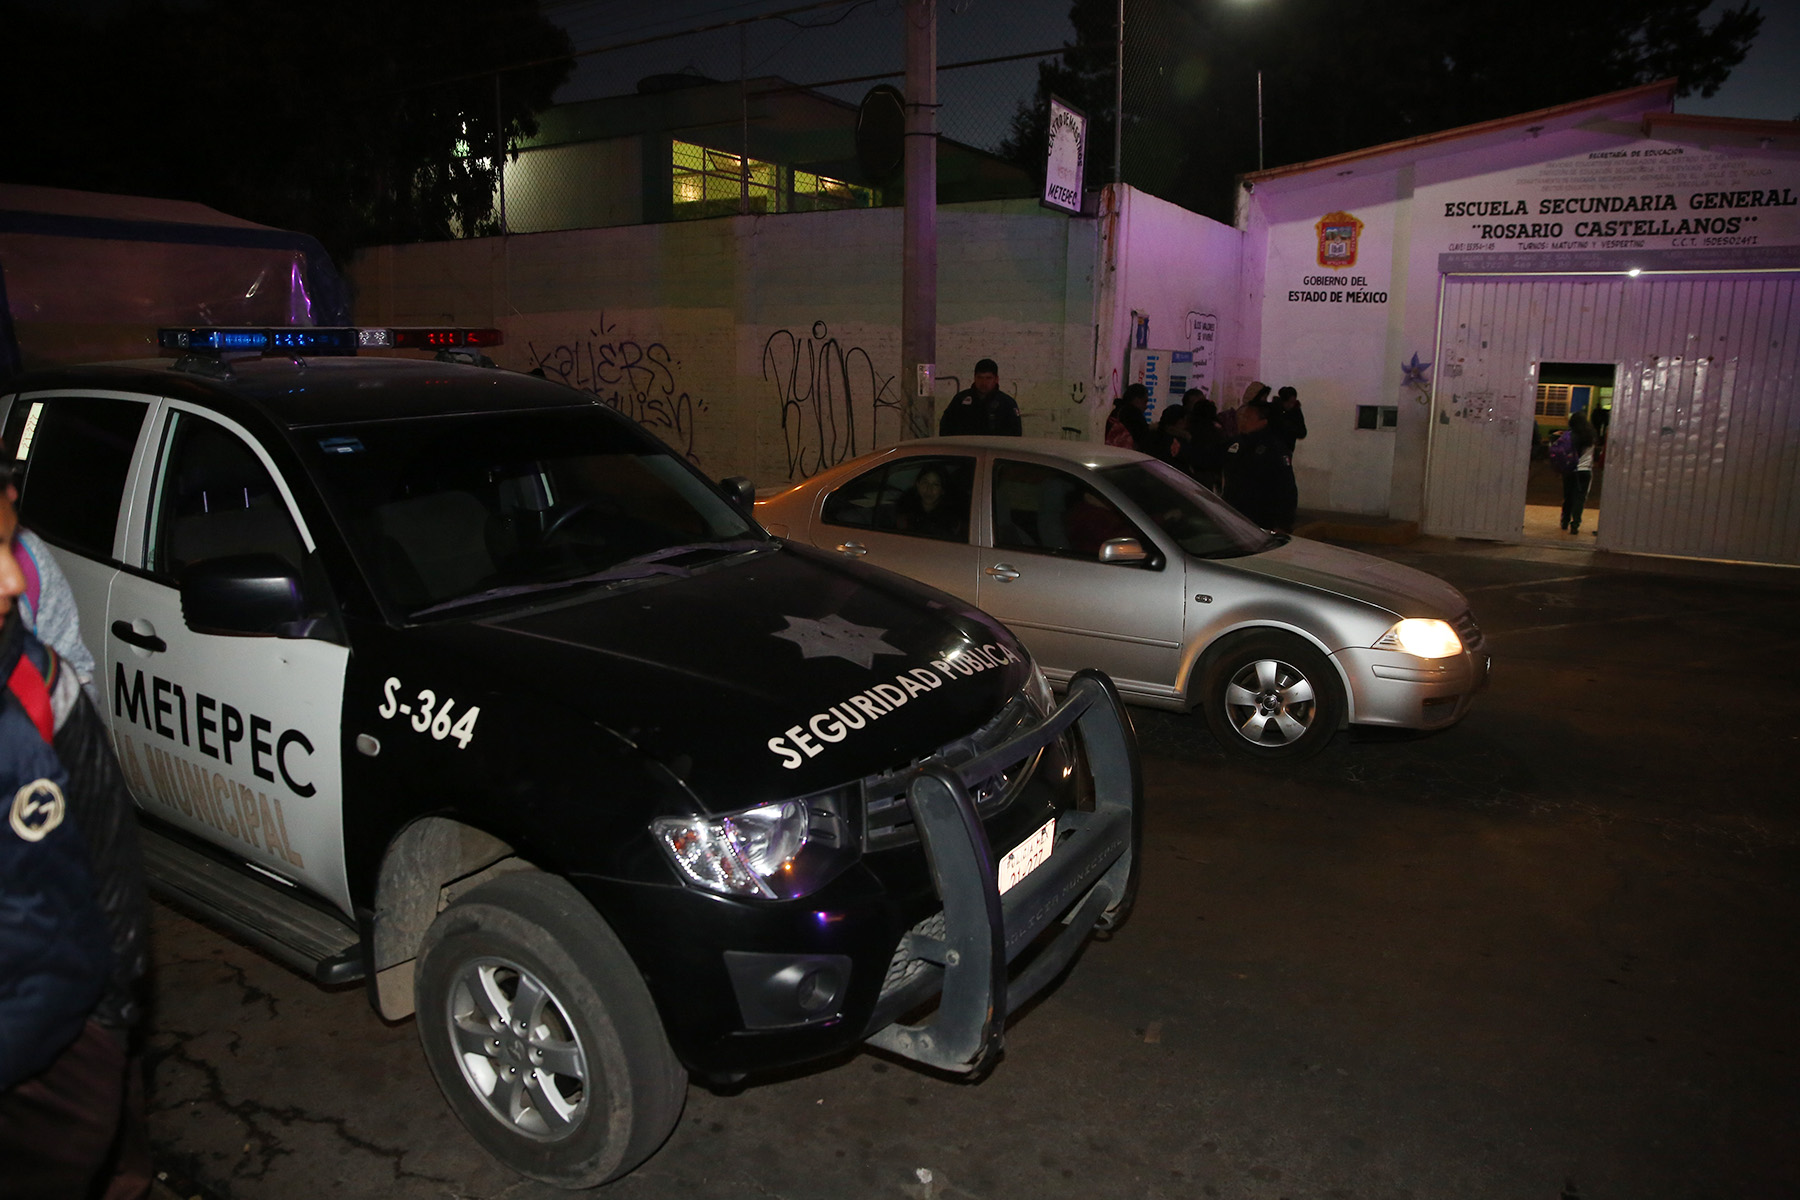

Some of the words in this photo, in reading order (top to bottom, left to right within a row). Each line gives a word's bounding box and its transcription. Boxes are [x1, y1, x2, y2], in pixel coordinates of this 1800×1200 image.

[1048, 182, 1078, 206] METEPEC
[1443, 199, 1529, 217] ESCUELA
[1538, 193, 1678, 215] SECUNDARIA
[1689, 188, 1798, 210] GENERAL
[1288, 290, 1327, 302] ESTADO
[1330, 290, 1344, 303] DE
[1346, 287, 1389, 304] MÉXICO
[1303, 275, 1348, 286] GOBIERNO
[1351, 276, 1368, 287] DEL
[1144, 355, 1160, 424] infinitu
[378, 676, 481, 750] S-364
[767, 667, 943, 770] SEGURIDAD
[929, 642, 1022, 681] PÚBLICA
[143, 742, 305, 870] MUNICIPAL
